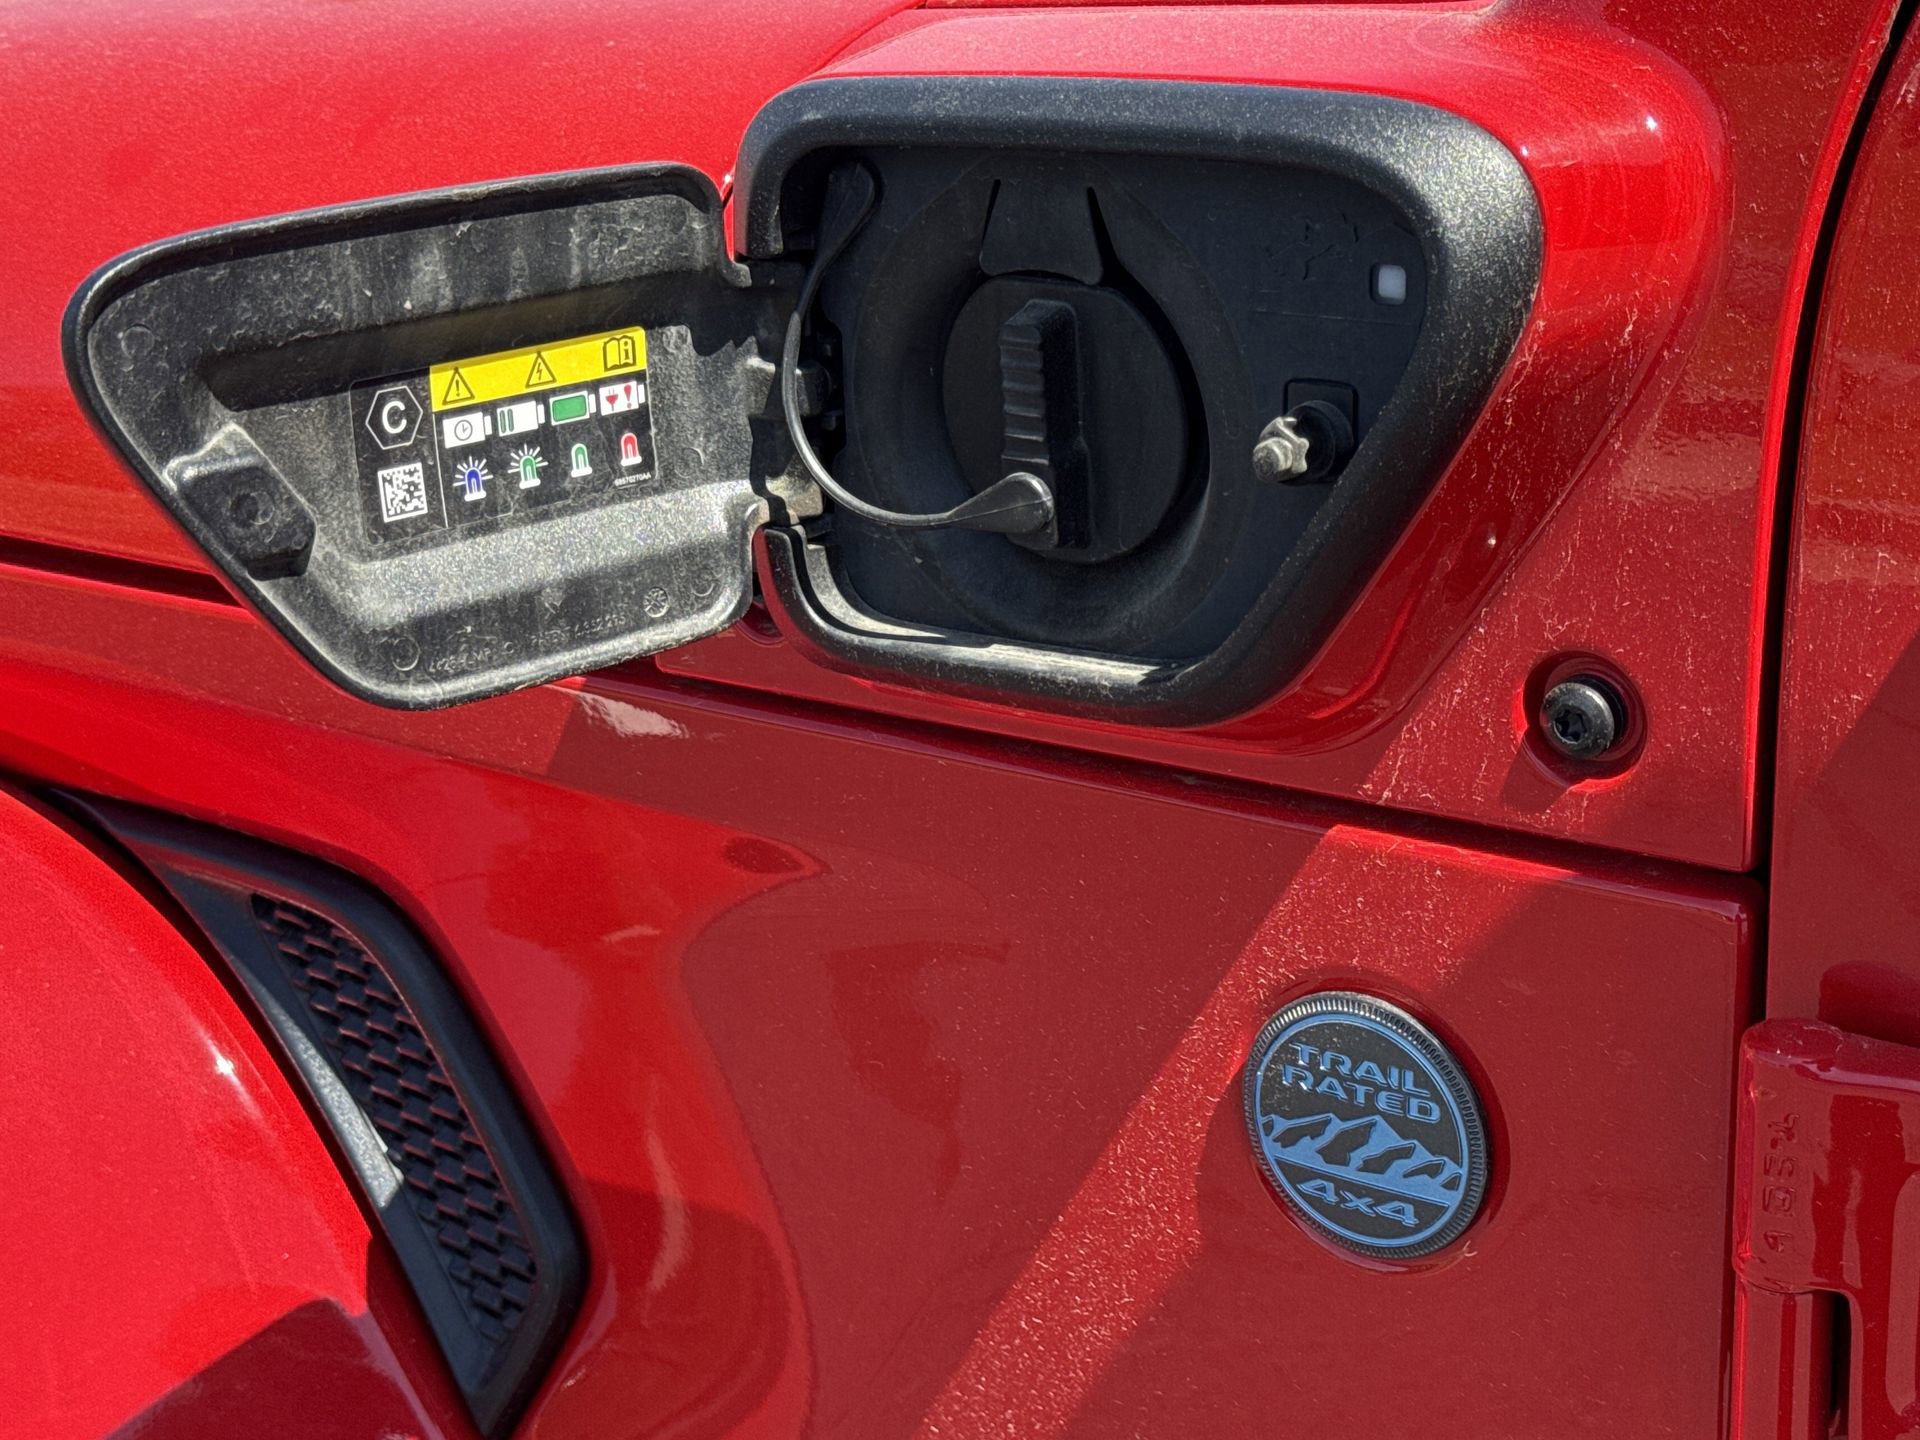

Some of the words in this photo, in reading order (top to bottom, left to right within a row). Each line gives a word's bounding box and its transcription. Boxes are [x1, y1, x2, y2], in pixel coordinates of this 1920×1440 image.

[382, 400, 407, 434] C
[1282, 1064, 1441, 1124] RATED
[1289, 1042, 1431, 1098] TRAIL
